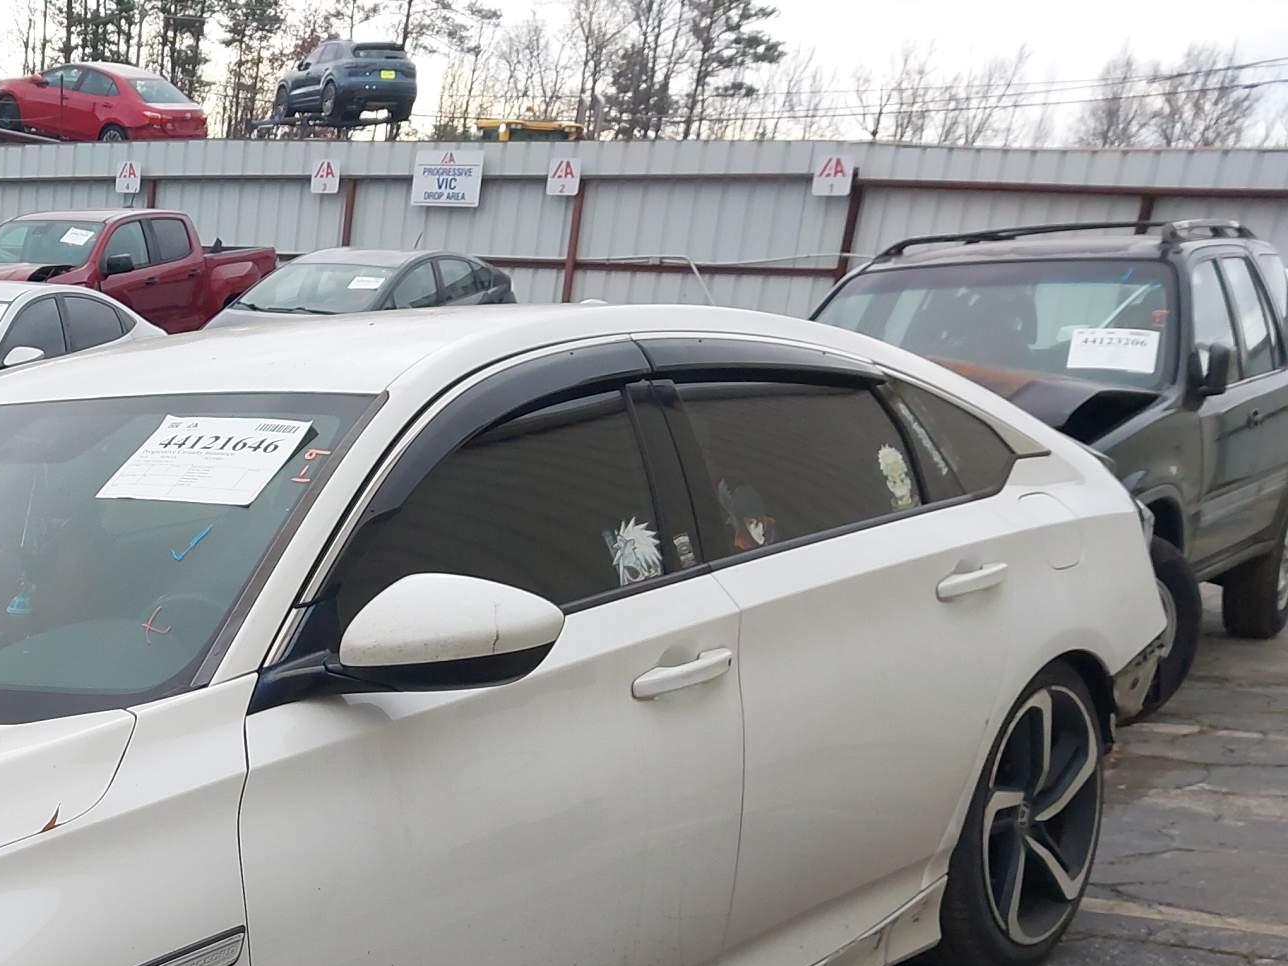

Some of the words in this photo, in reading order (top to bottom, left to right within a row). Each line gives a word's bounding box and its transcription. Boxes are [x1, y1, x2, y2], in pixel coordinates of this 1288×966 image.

[423, 167, 472, 176] PROGRESSIVE
[437, 177, 457, 190] VIC
[559, 183, 566, 193] 2
[423, 191, 444, 200] DROP
[446, 192, 466, 201] AREA
[159, 435, 286, 454] 44121646
